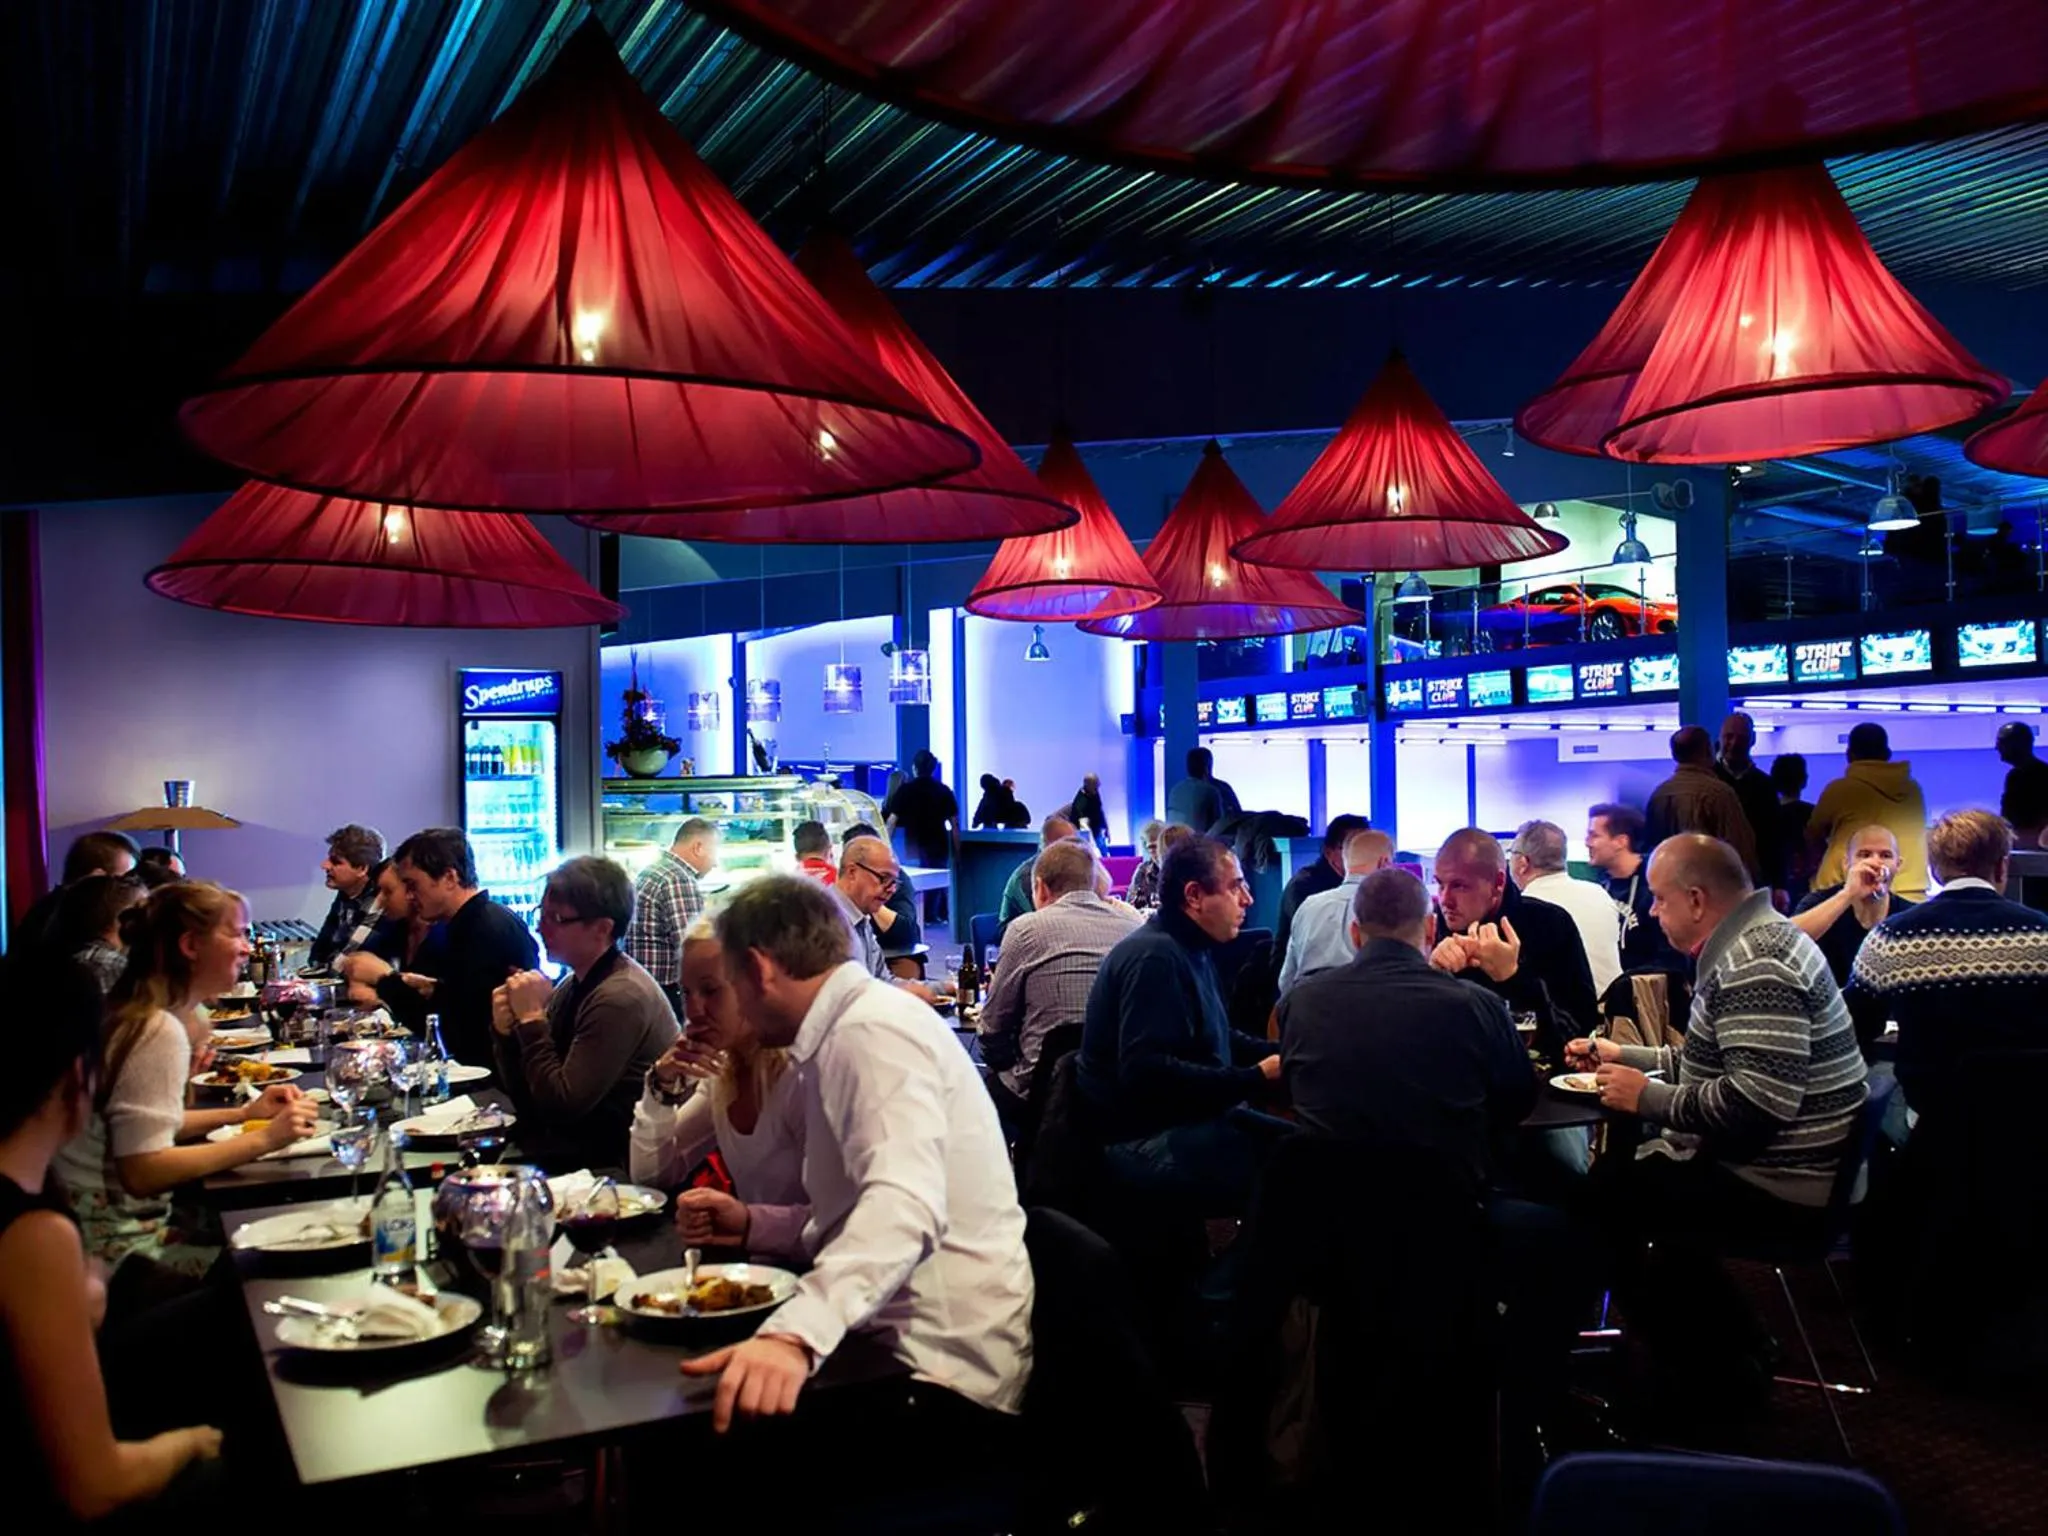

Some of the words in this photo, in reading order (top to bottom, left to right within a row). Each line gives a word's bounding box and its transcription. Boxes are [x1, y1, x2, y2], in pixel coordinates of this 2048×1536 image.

[1795, 641, 1852, 660] STRIKE
[1579, 663, 1624, 679] STRIKE
[1801, 657, 1841, 674] CLUB
[1427, 678, 1463, 693] STRIKE
[1584, 676, 1615, 691] CLUB
[465, 676, 553, 709] Spendrups
